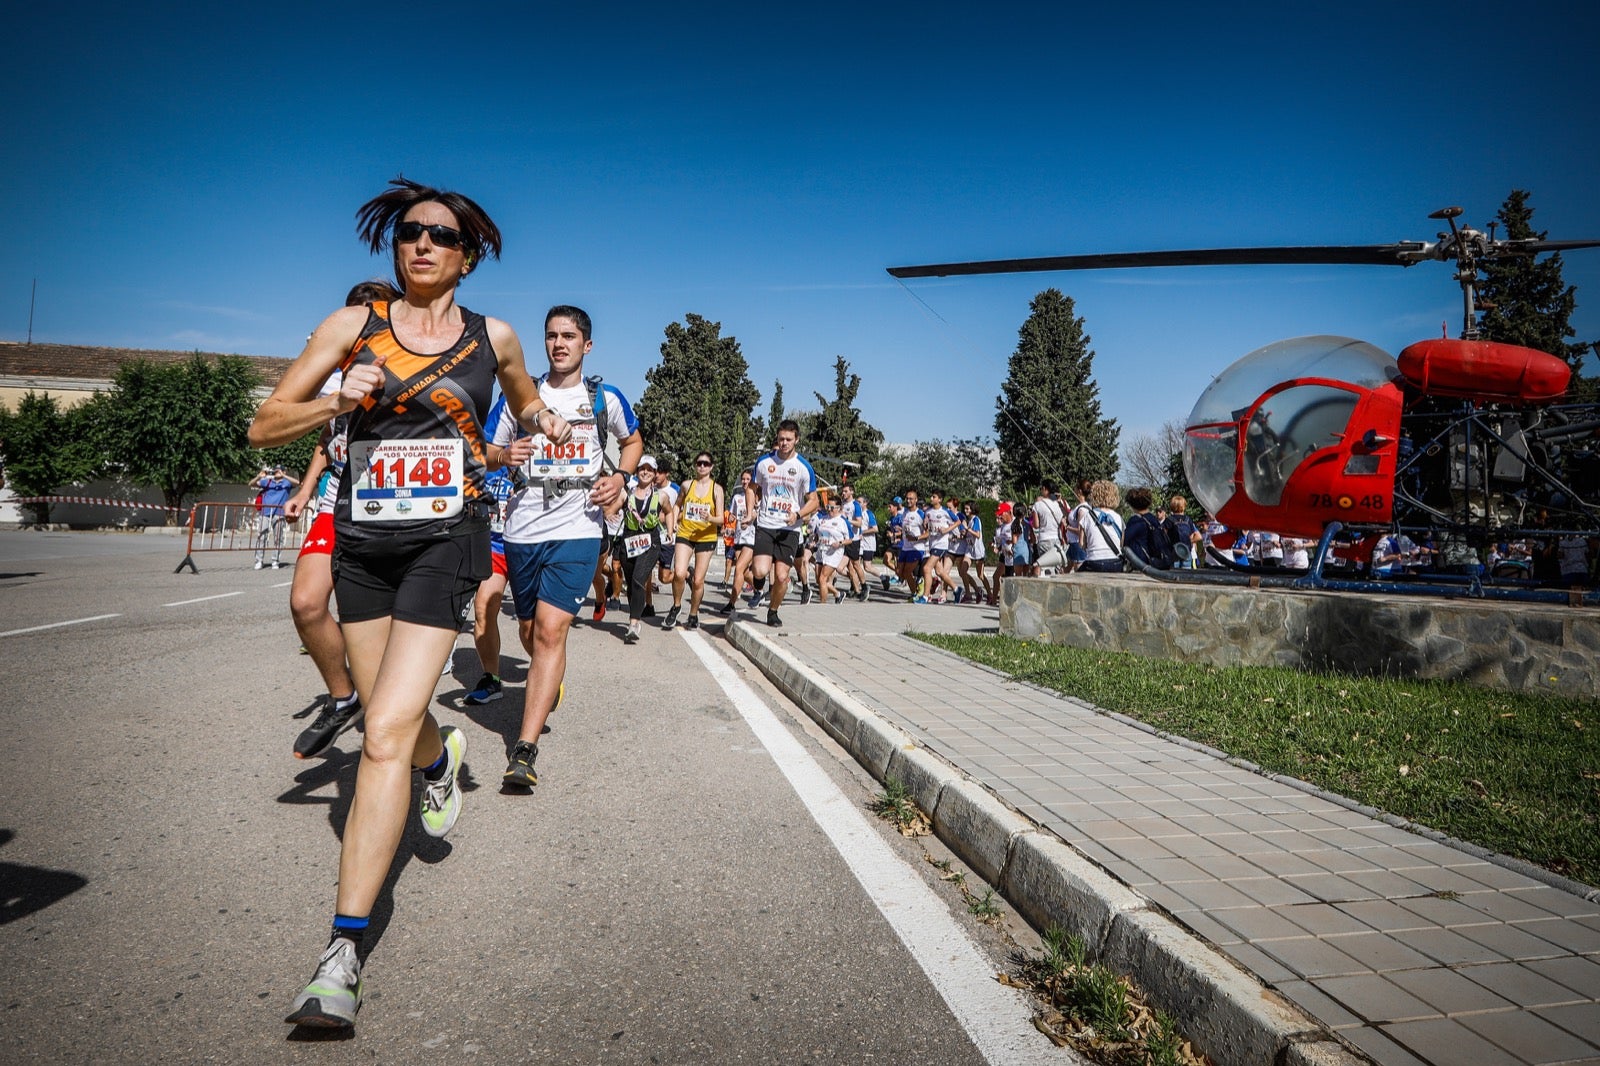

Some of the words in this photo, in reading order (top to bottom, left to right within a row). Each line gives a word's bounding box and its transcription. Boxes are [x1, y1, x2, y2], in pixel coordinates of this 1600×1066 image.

[396, 373, 438, 402] GRANADA
[436, 368, 445, 377] X
[441, 363, 453, 373] EL
[543, 442, 586, 460] 1031
[370, 457, 452, 489] 1148
[394, 488, 413, 498] SONIA
[1310, 493, 1333, 508] 78
[1360, 494, 1384, 510] 48
[772, 501, 793, 513] 1102
